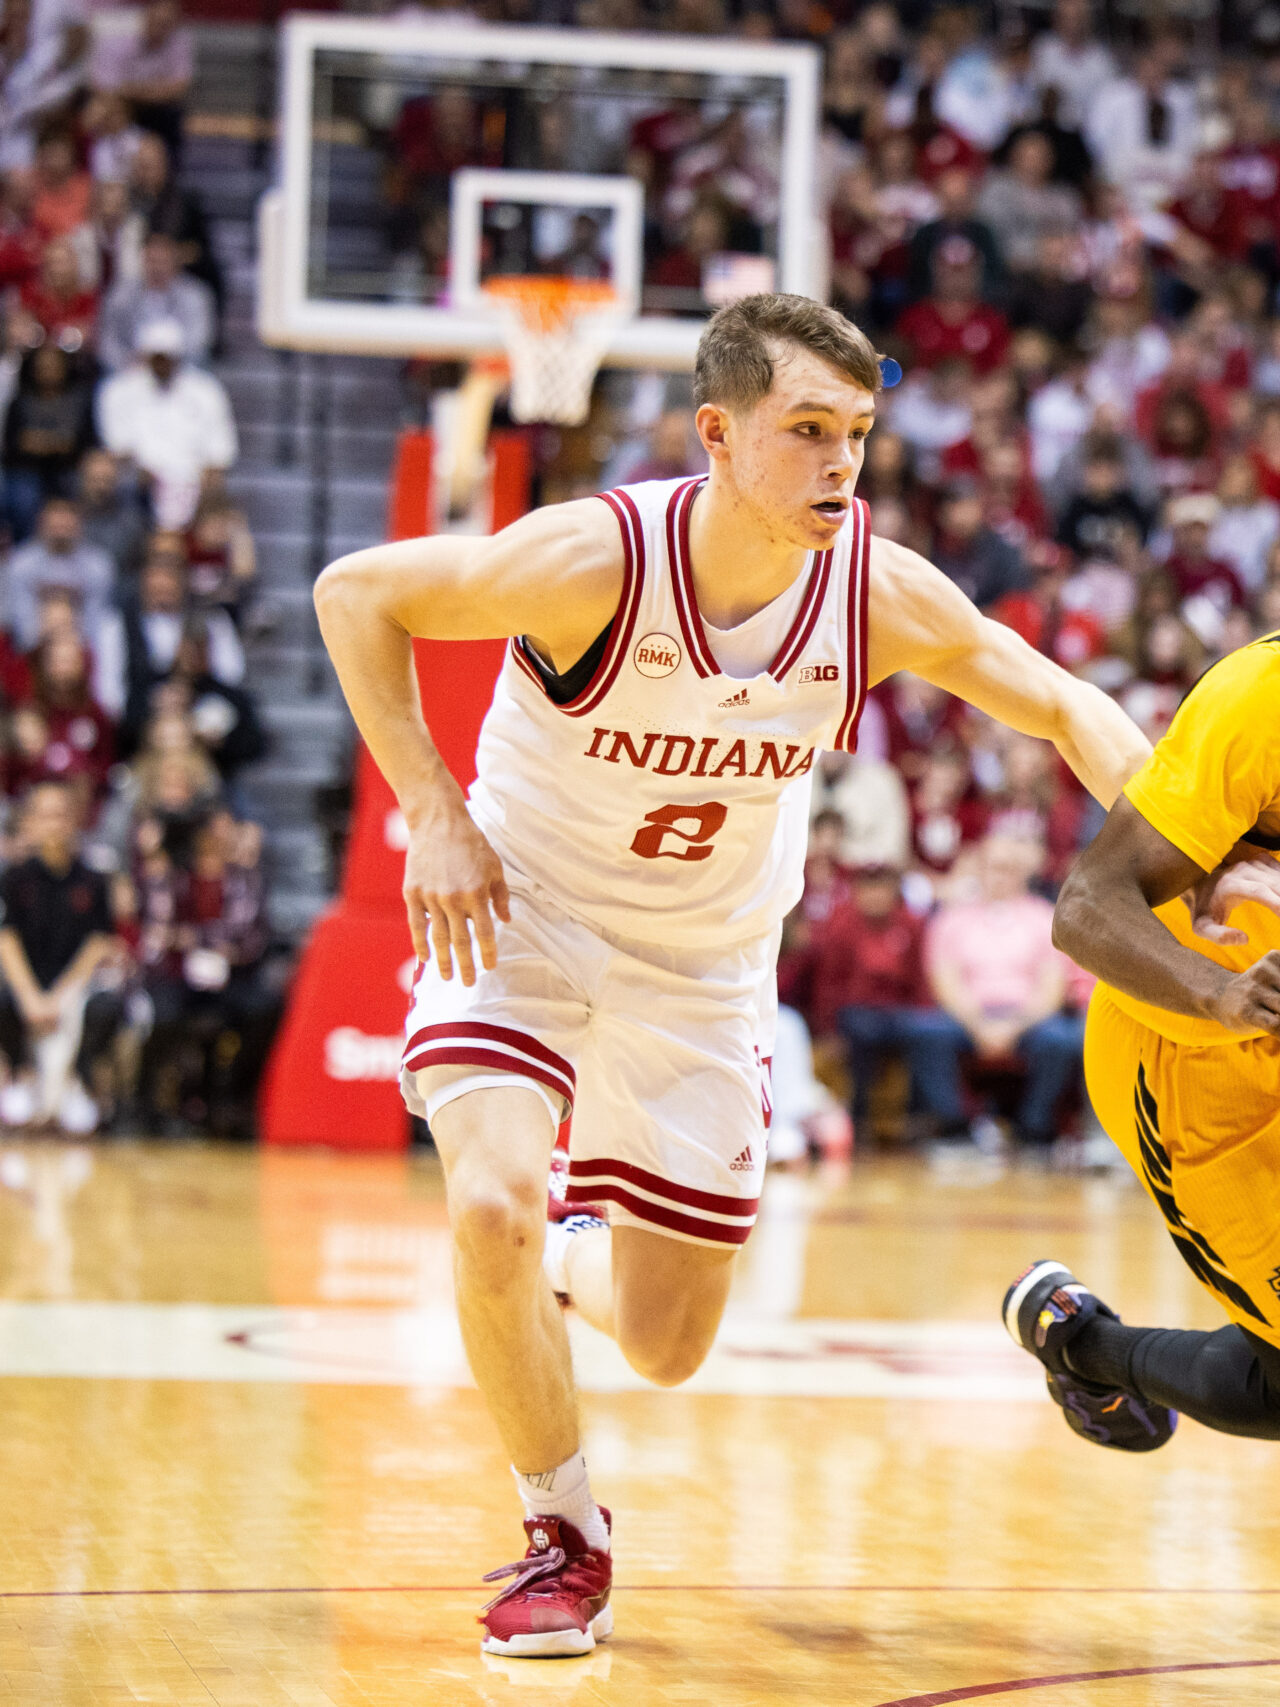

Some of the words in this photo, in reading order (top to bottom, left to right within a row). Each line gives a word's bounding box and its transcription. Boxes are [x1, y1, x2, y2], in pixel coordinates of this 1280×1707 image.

[638, 648, 677, 668] RMK
[718, 698, 751, 708] adidas
[584, 727, 815, 780] INDIANA
[629, 801, 728, 862] 2
[729, 1162, 755, 1171] adida
